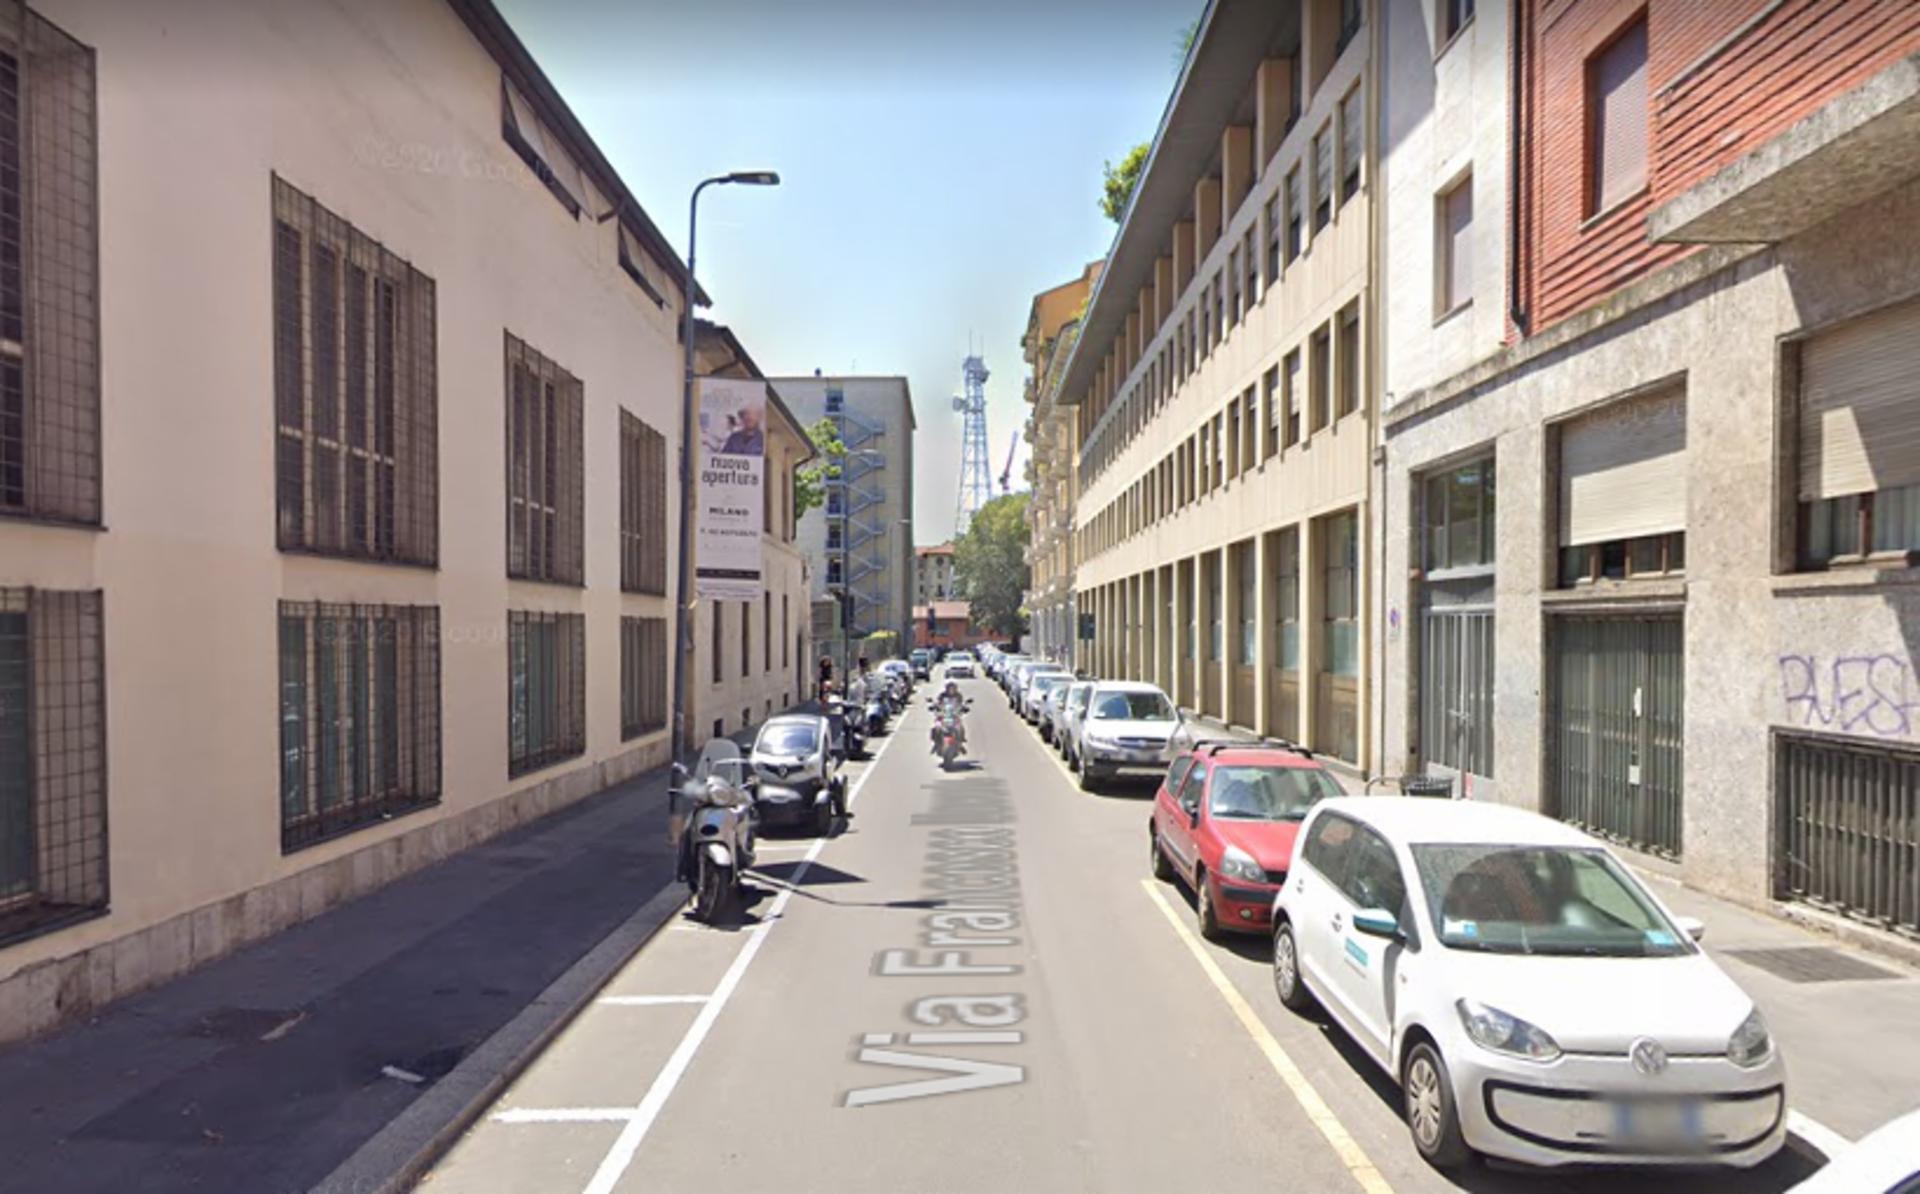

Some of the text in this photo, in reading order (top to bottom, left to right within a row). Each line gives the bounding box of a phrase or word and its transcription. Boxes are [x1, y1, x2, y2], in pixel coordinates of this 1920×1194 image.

[711, 457, 750, 471] nuova
[702, 470, 759, 487] apertura
[709, 507, 750, 516] MILANO
